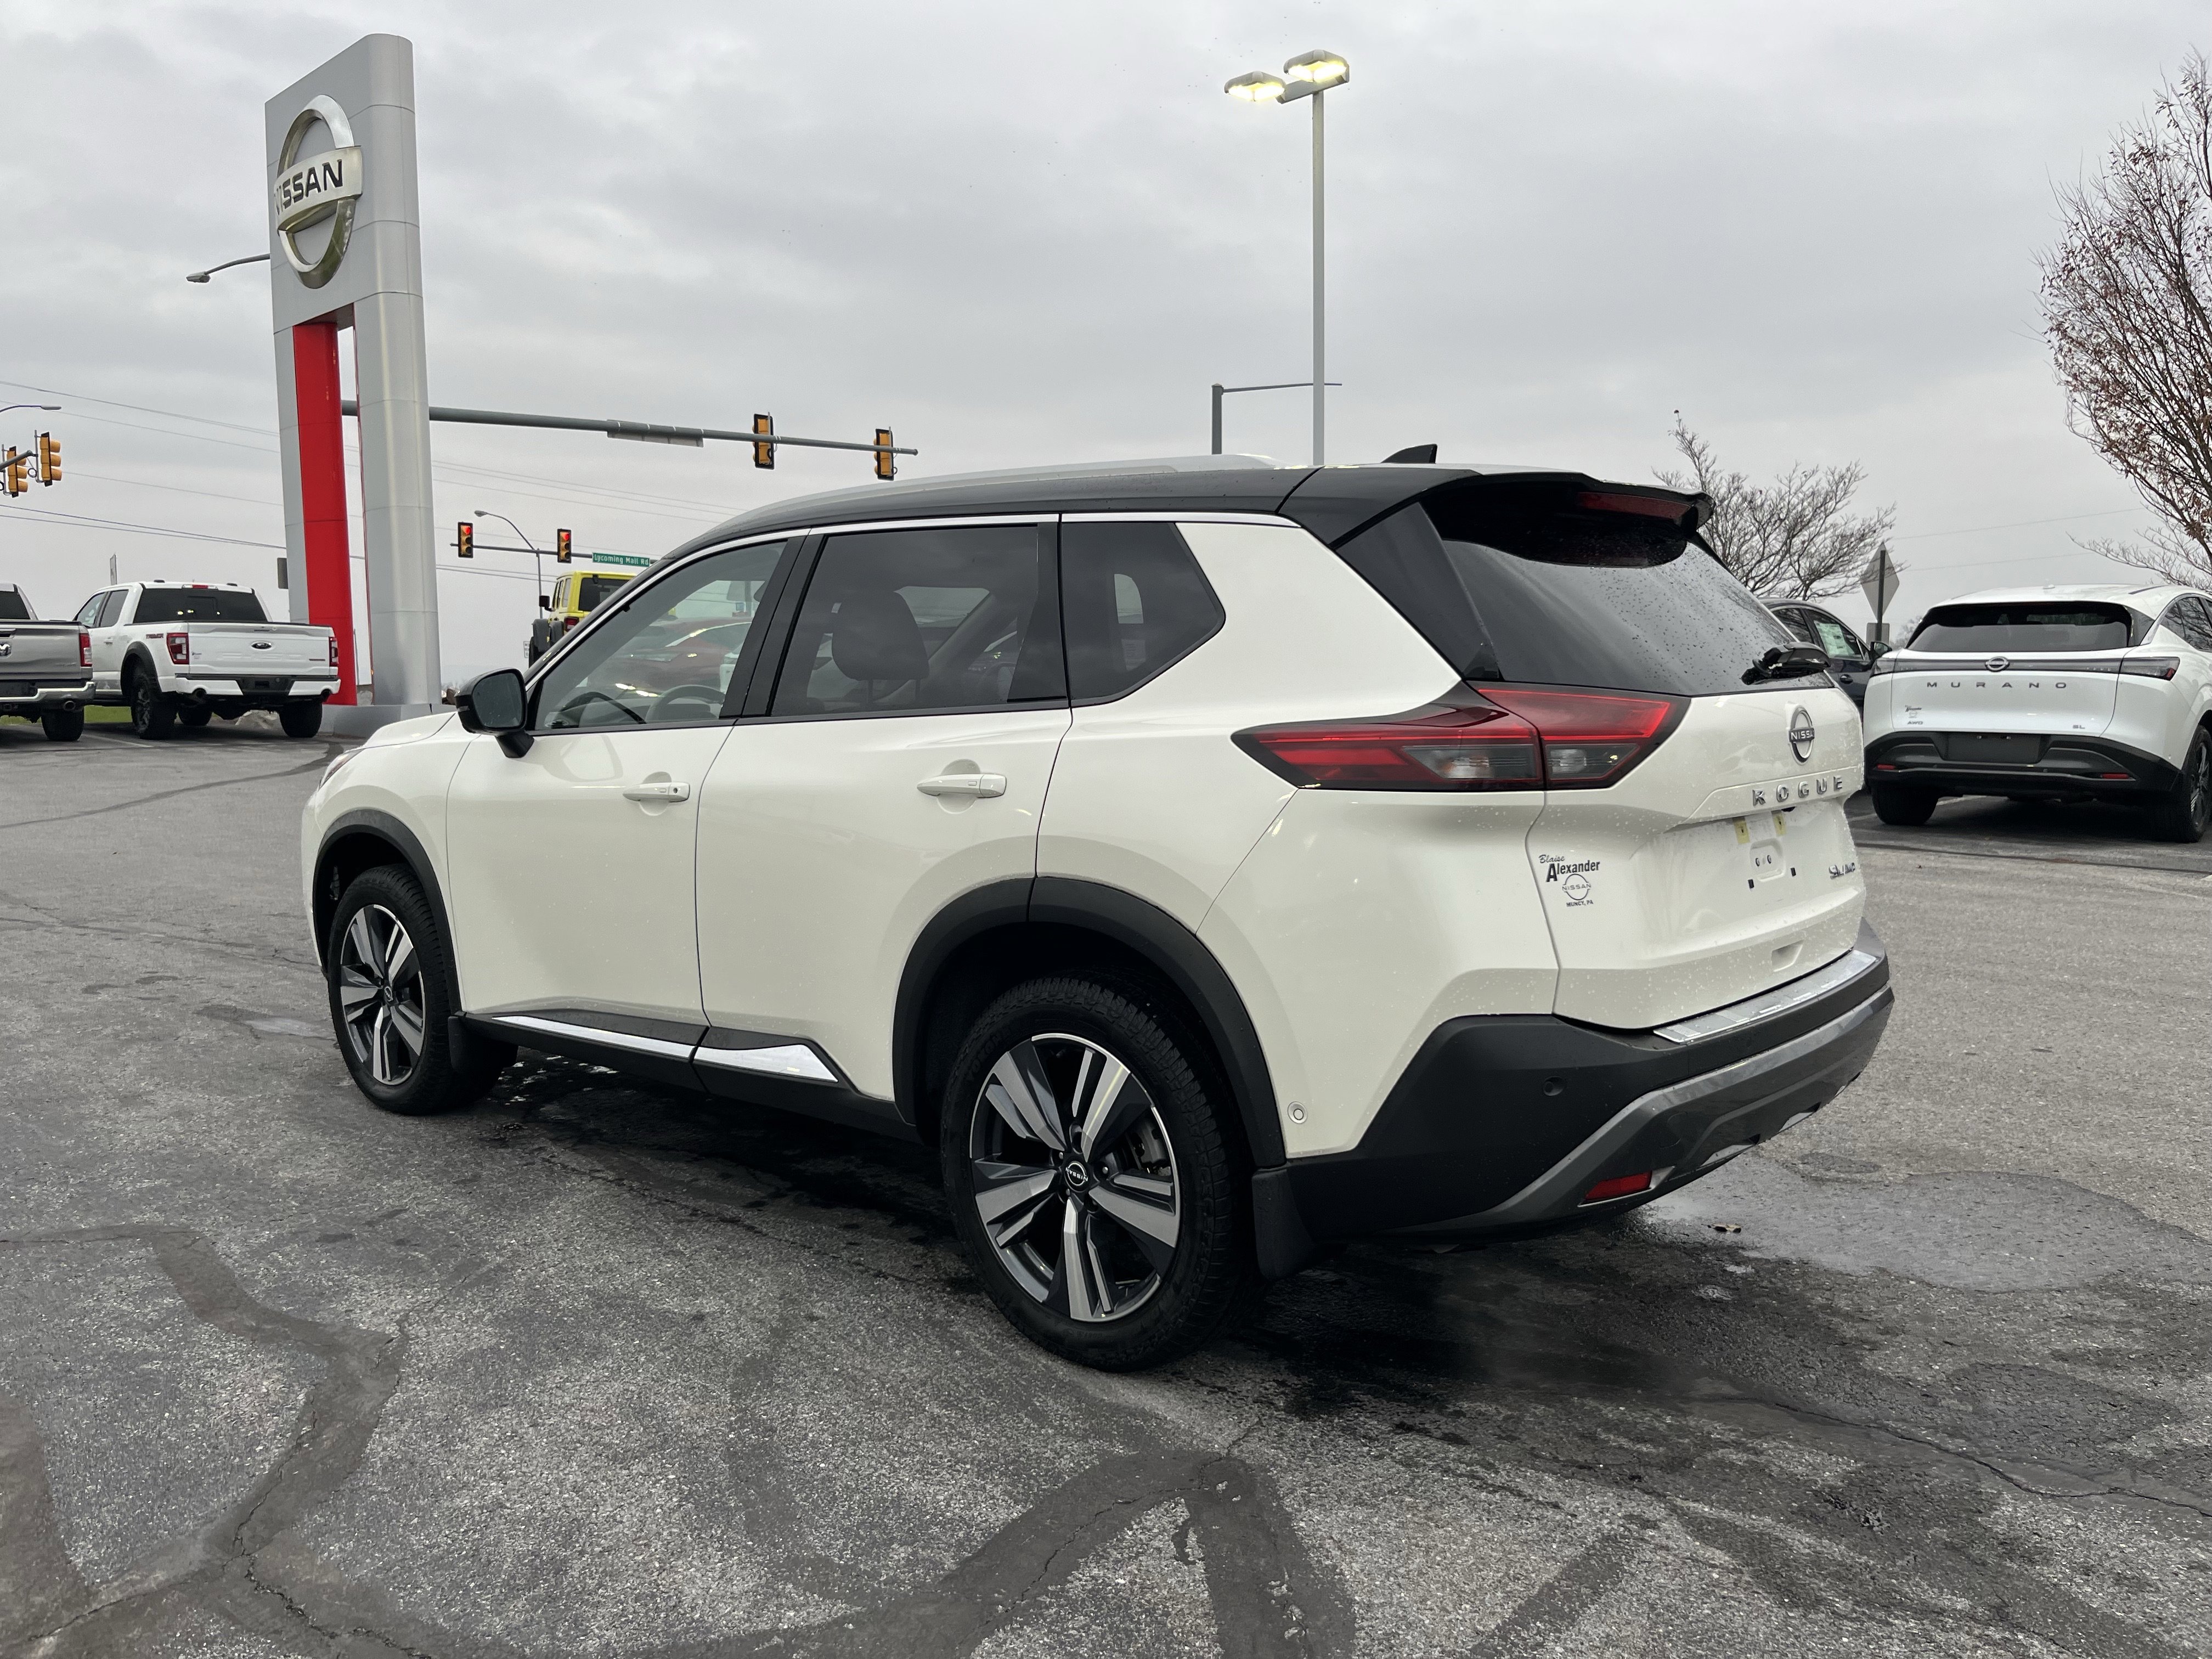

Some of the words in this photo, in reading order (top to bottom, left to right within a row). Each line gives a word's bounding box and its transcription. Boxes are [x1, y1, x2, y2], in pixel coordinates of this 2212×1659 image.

[274, 159, 343, 216] NISSAN
[594, 554, 624, 565] Lycoming
[1752, 775, 1842, 806] ROGUE
[1538, 854, 1565, 864] Blaise
[1545, 860, 1600, 882] Alexander
